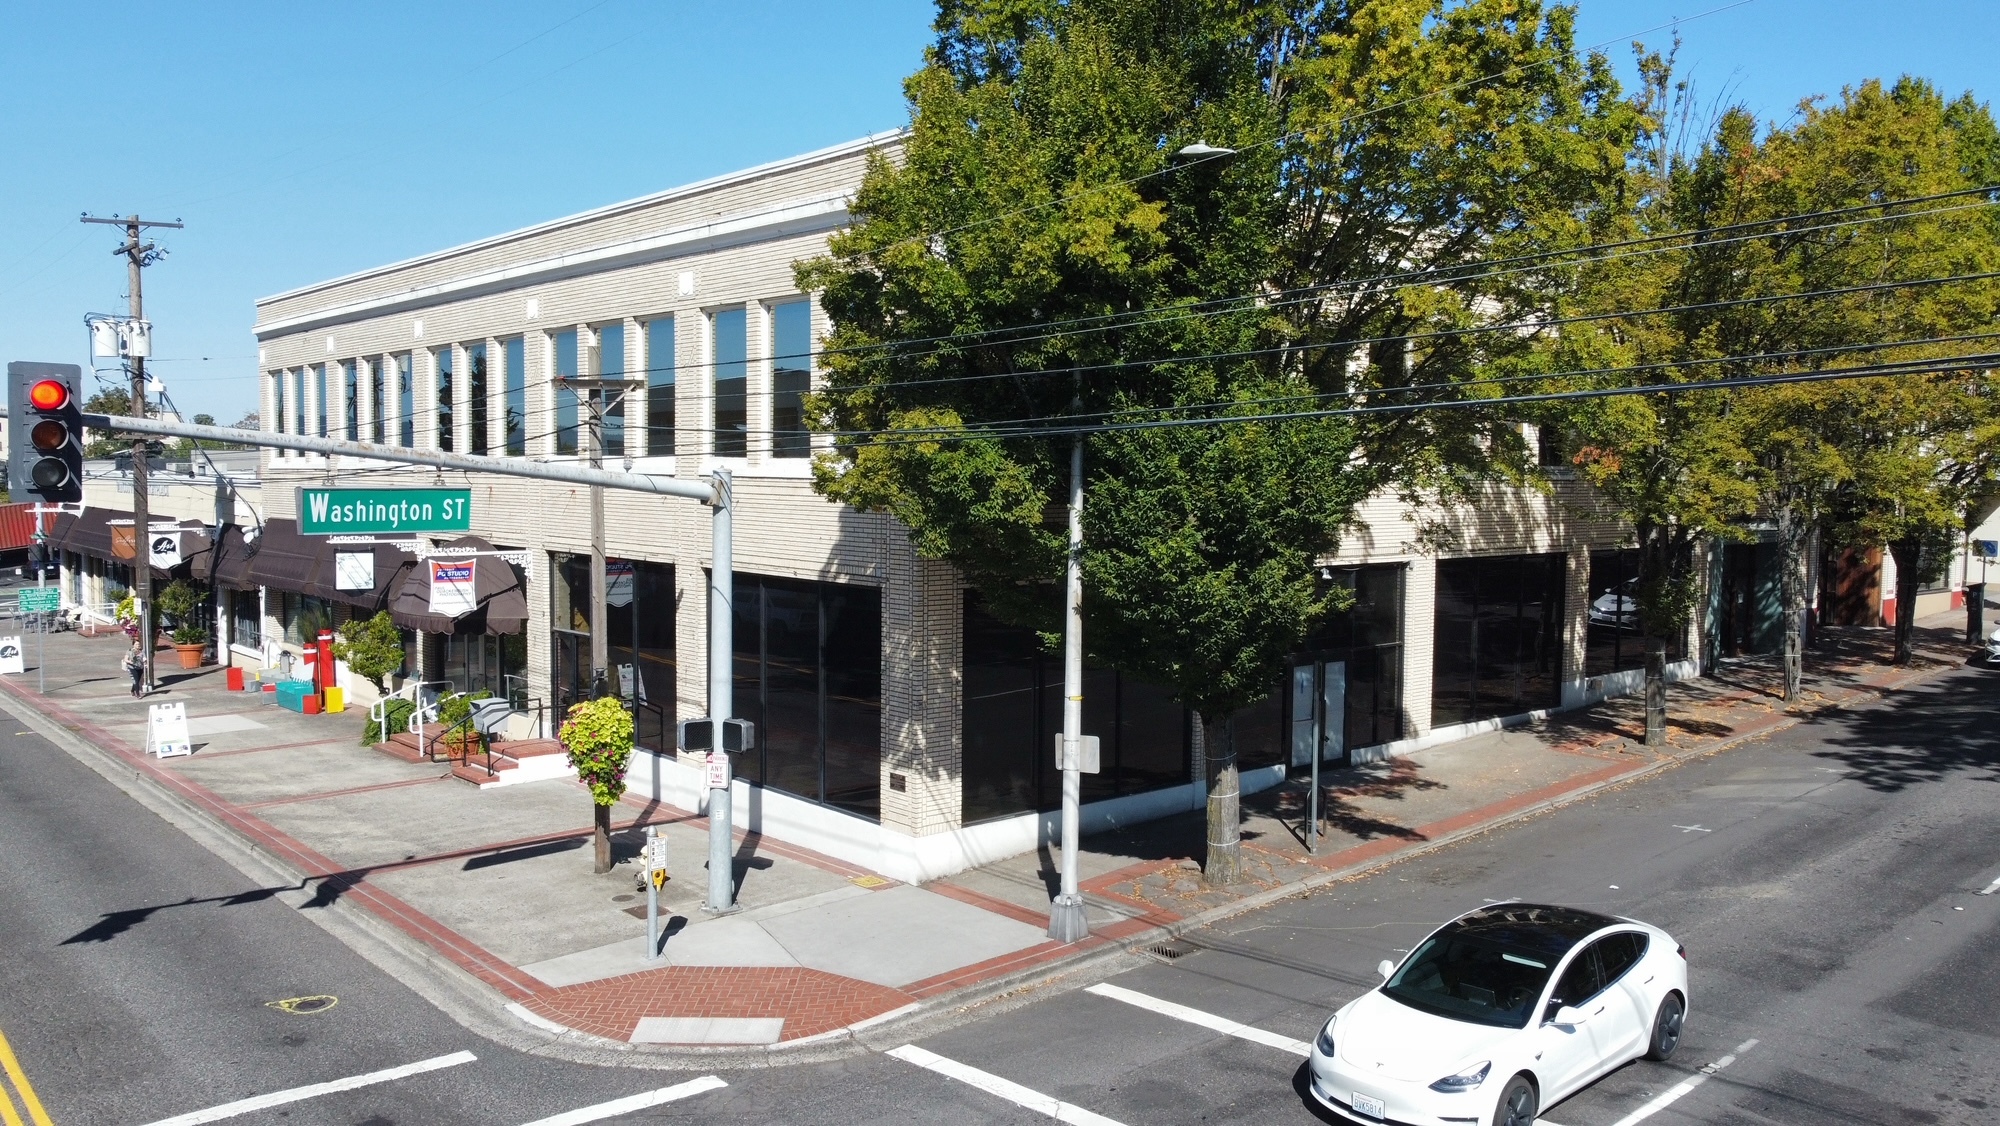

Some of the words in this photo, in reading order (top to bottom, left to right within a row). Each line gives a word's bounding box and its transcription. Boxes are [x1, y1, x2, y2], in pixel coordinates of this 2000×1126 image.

[309, 493, 432, 528] Washington
[442, 498, 465, 520] ST
[710, 773, 724, 781] TIME
